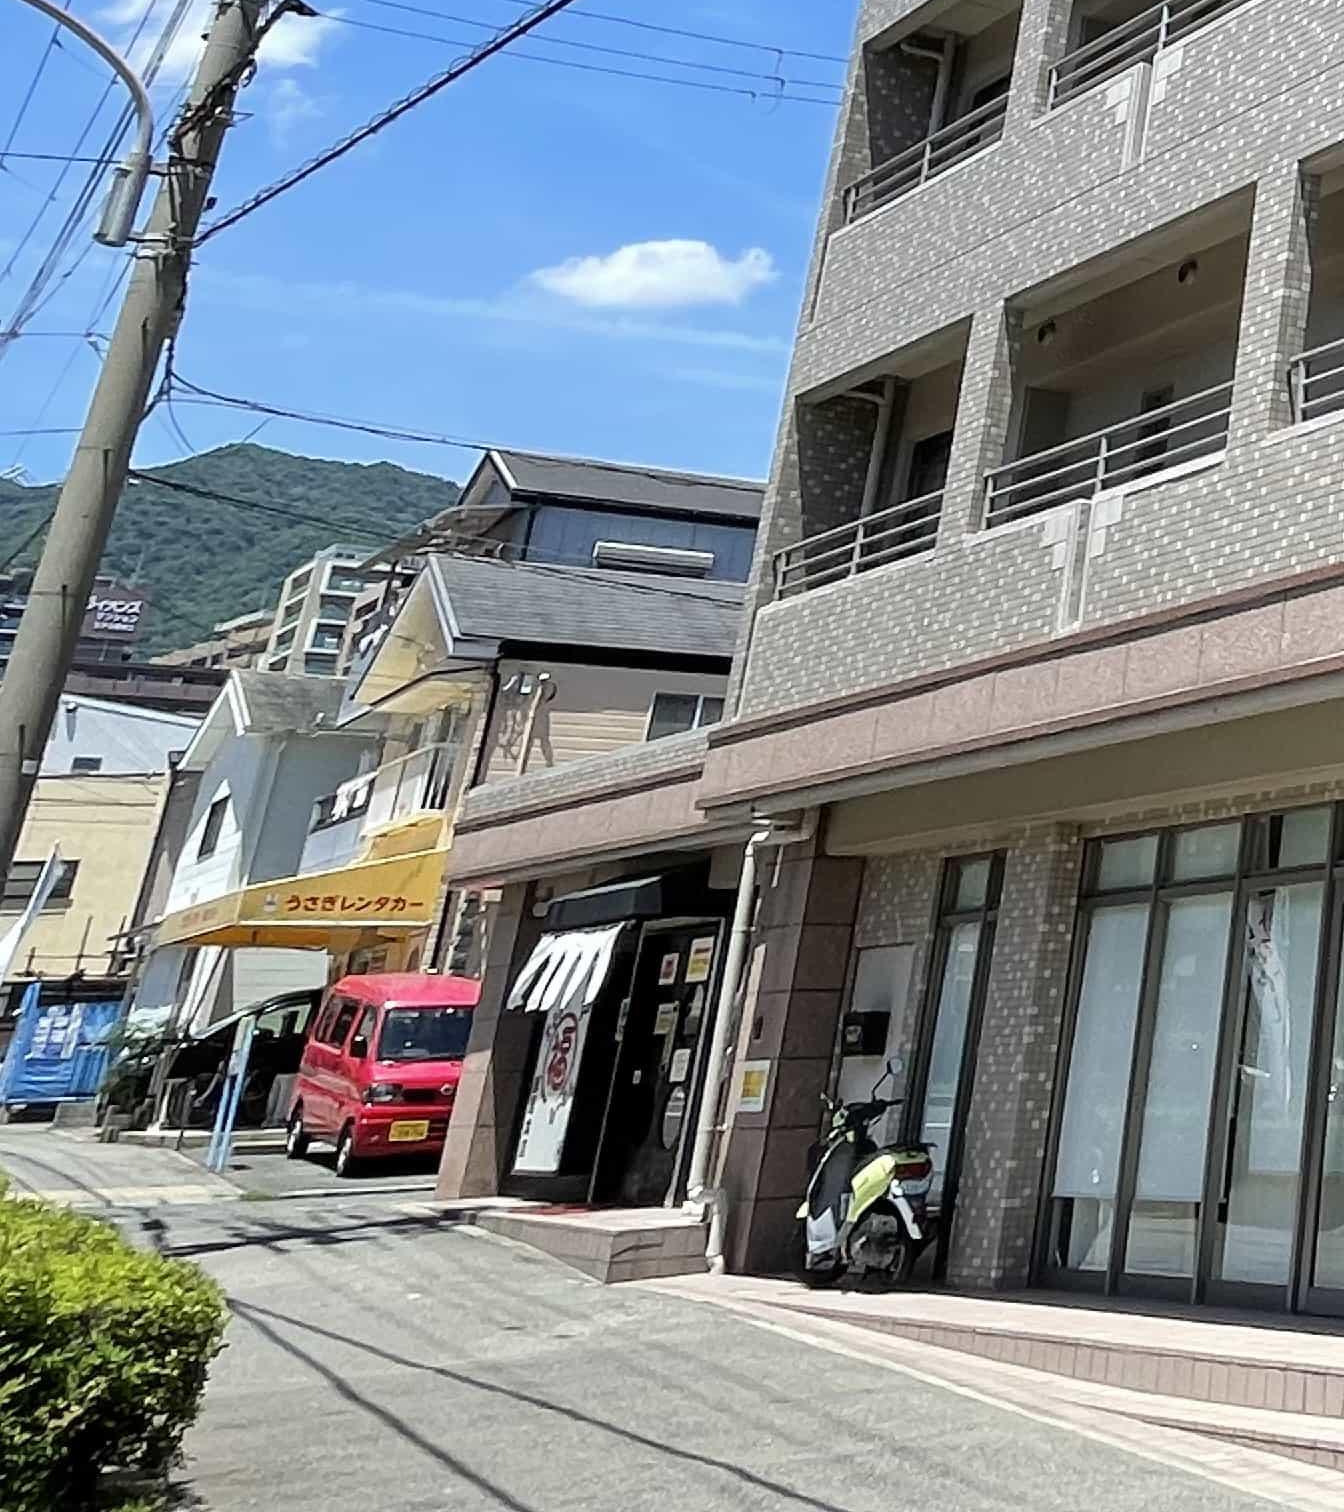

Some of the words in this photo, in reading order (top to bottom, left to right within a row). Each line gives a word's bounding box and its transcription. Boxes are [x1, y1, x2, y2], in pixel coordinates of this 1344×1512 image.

[285, 894, 425, 913] うさぎレンタカー
